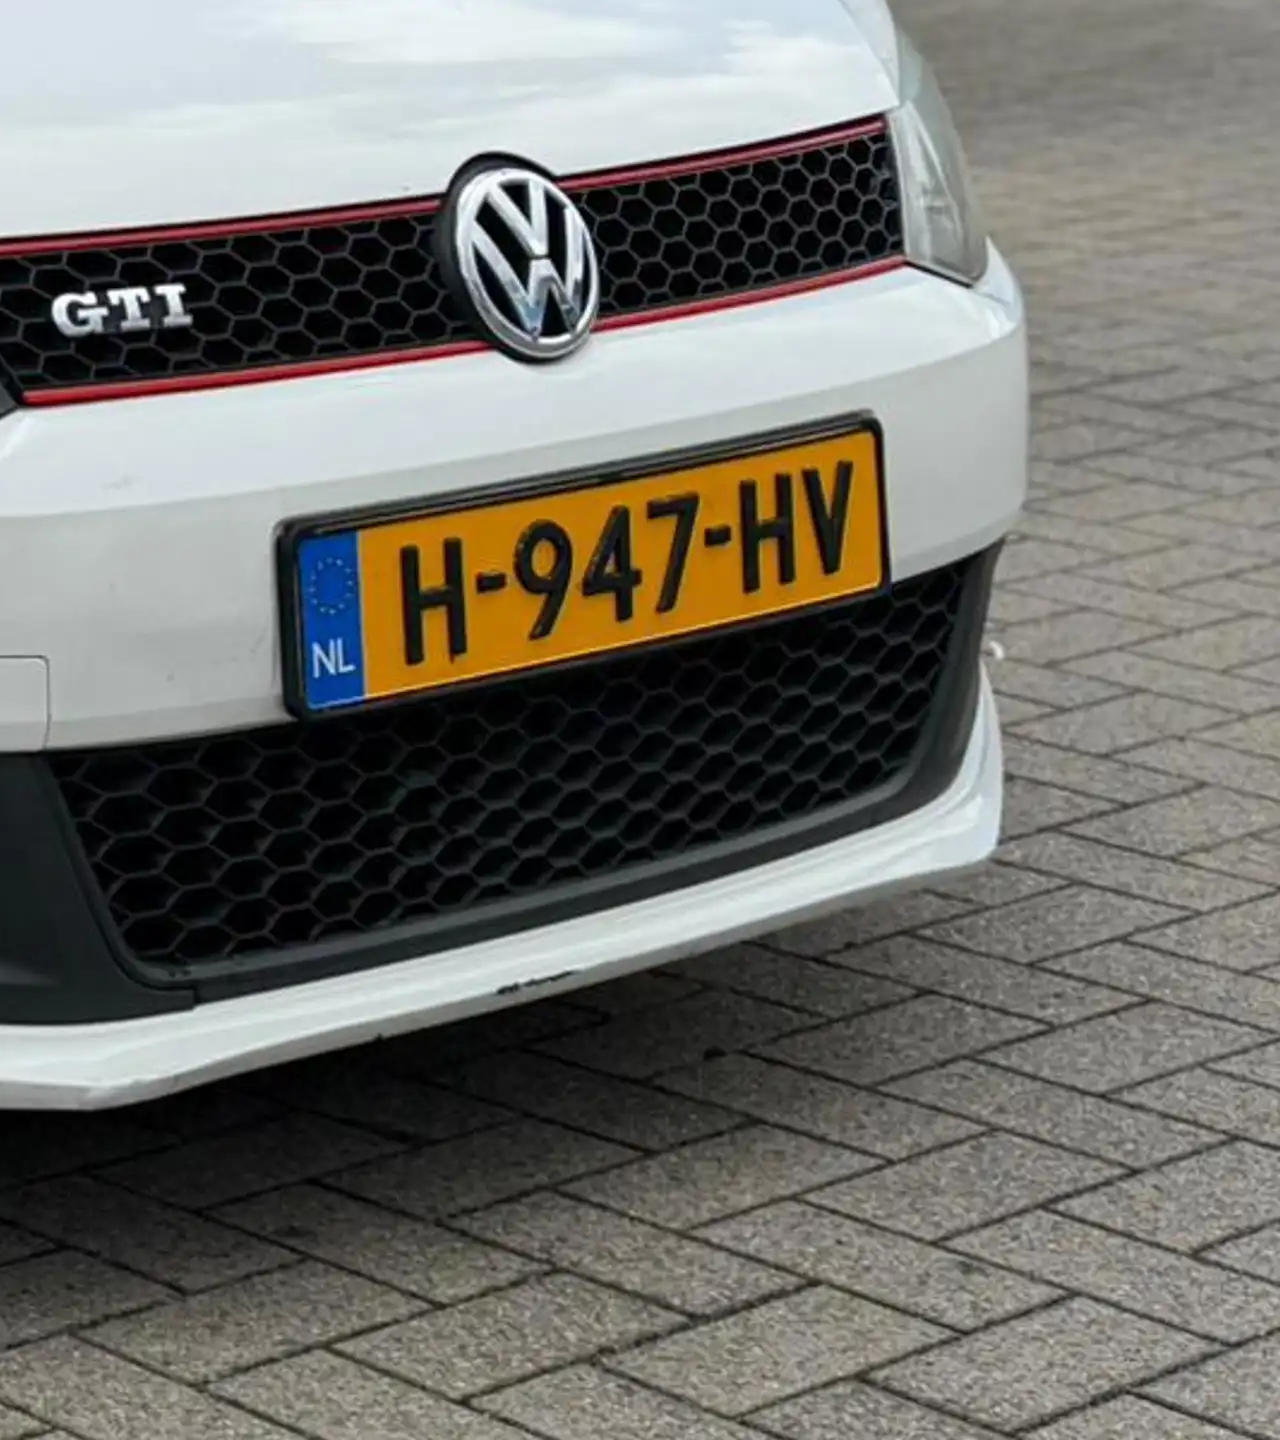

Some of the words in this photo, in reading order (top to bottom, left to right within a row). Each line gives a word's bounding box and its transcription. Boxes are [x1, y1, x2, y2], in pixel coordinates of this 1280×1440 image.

[51, 283, 193, 338] GTI
[460, 169, 598, 355] VW
[399, 460, 853, 666] H-947-HV
[312, 639, 356, 680] NL
